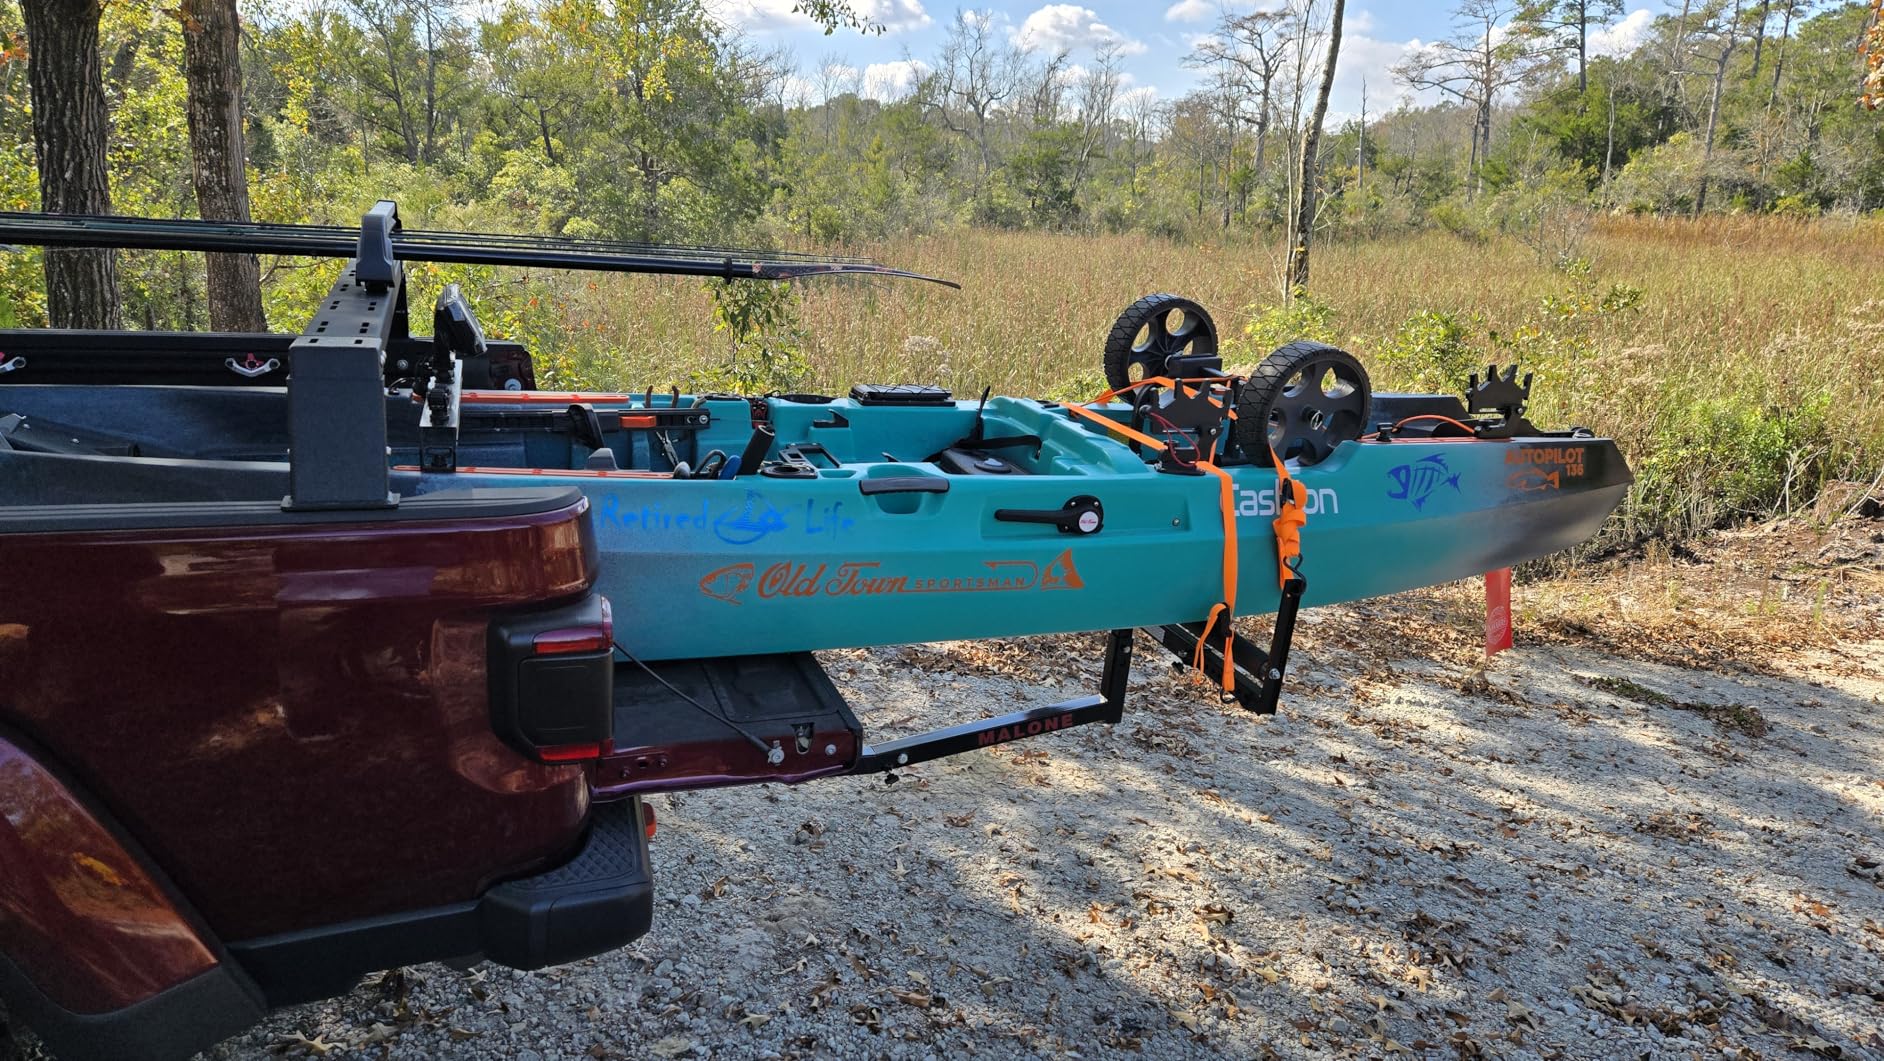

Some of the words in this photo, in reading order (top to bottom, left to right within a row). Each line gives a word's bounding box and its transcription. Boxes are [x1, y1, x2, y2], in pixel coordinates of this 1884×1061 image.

[1505, 446, 1584, 465] AUTOPILOT
[1220, 479, 1338, 516] ason
[601, 494, 709, 529] Retired
[806, 499, 856, 540] Life
[758, 560, 827, 599] Old
[825, 562, 908, 597] Town
[915, 577, 1026, 590] SPORTSMAN
[977, 713, 1073, 745] MALONE
